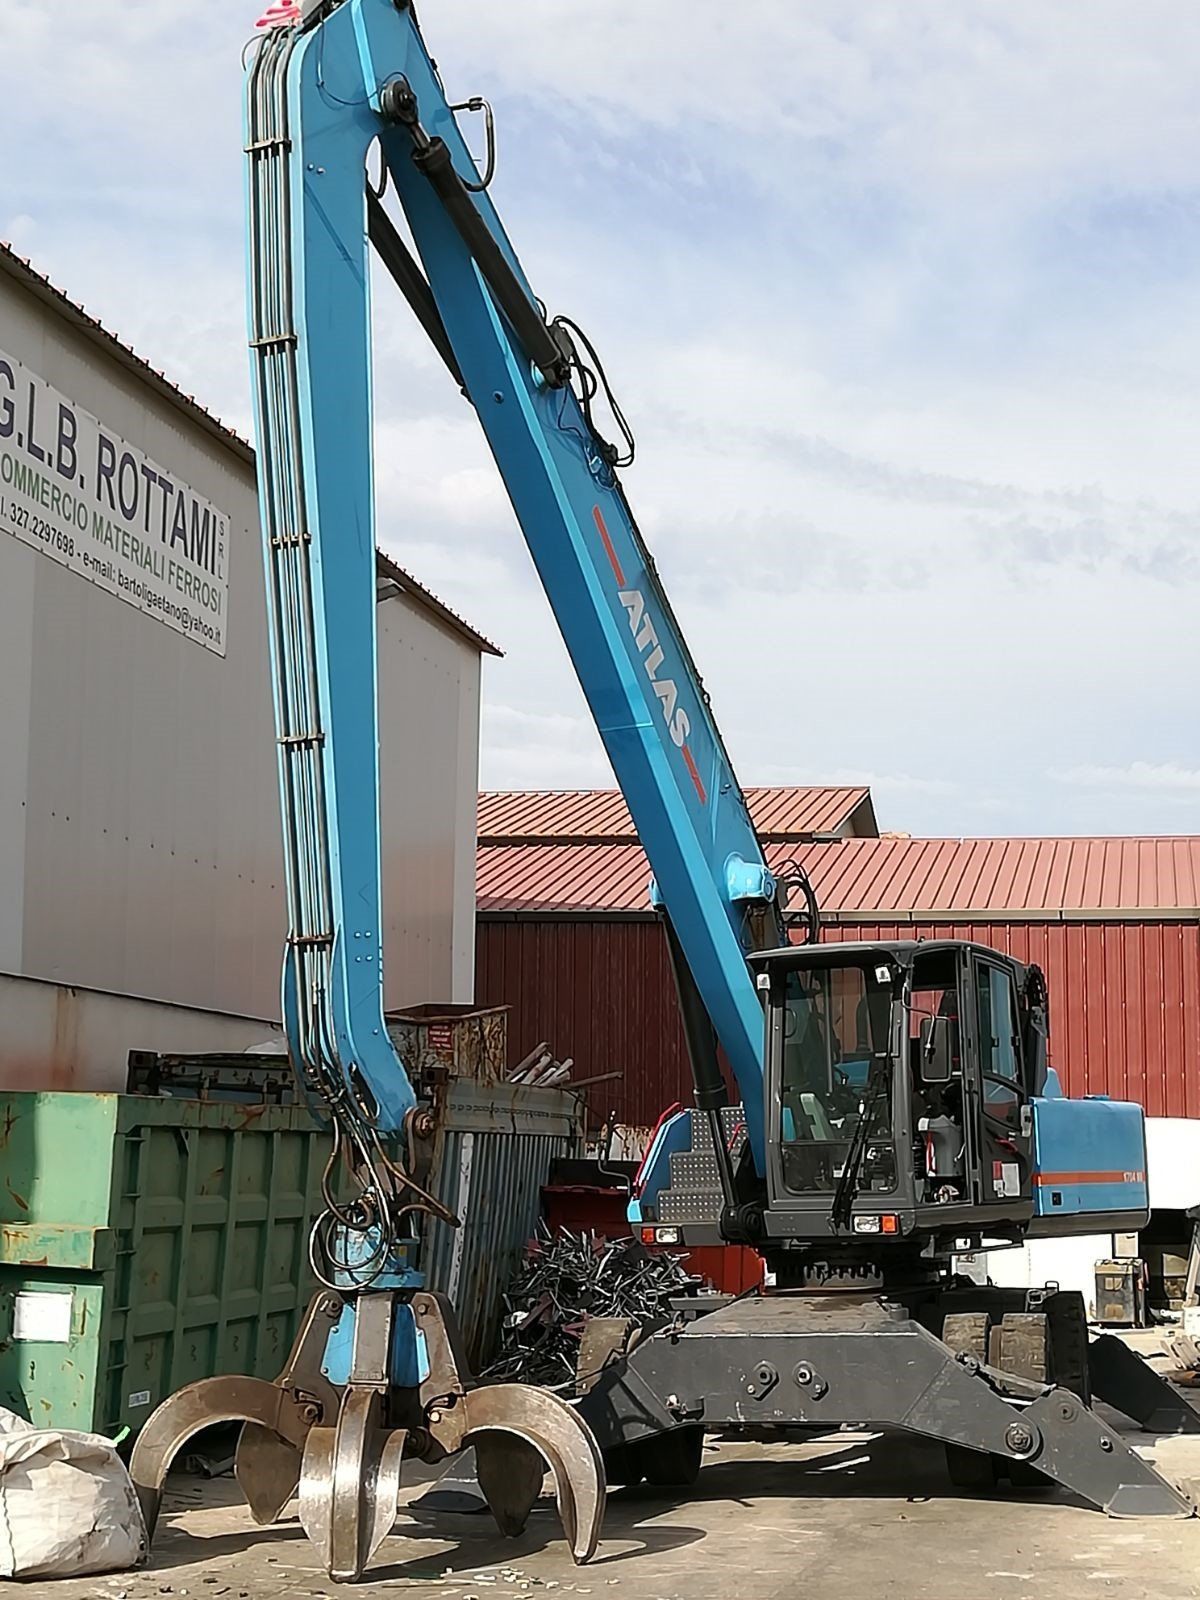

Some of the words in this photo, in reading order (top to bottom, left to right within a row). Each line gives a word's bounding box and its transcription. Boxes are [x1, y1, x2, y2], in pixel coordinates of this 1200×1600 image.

[0, 360, 84, 490] G.L.B.
[97, 433, 216, 575] ROTTAMI
[0, 453, 88, 531] OMMERCIO
[92, 511, 165, 580] MATERIALI
[168, 560, 221, 616] FERROSI
[10, 502, 75, 557] 327.2297698
[83, 552, 116, 582] e-mail:
[118, 568, 221, 645] bartoligaetano@yahoo.it
[617, 590, 690, 748] ATLAS
